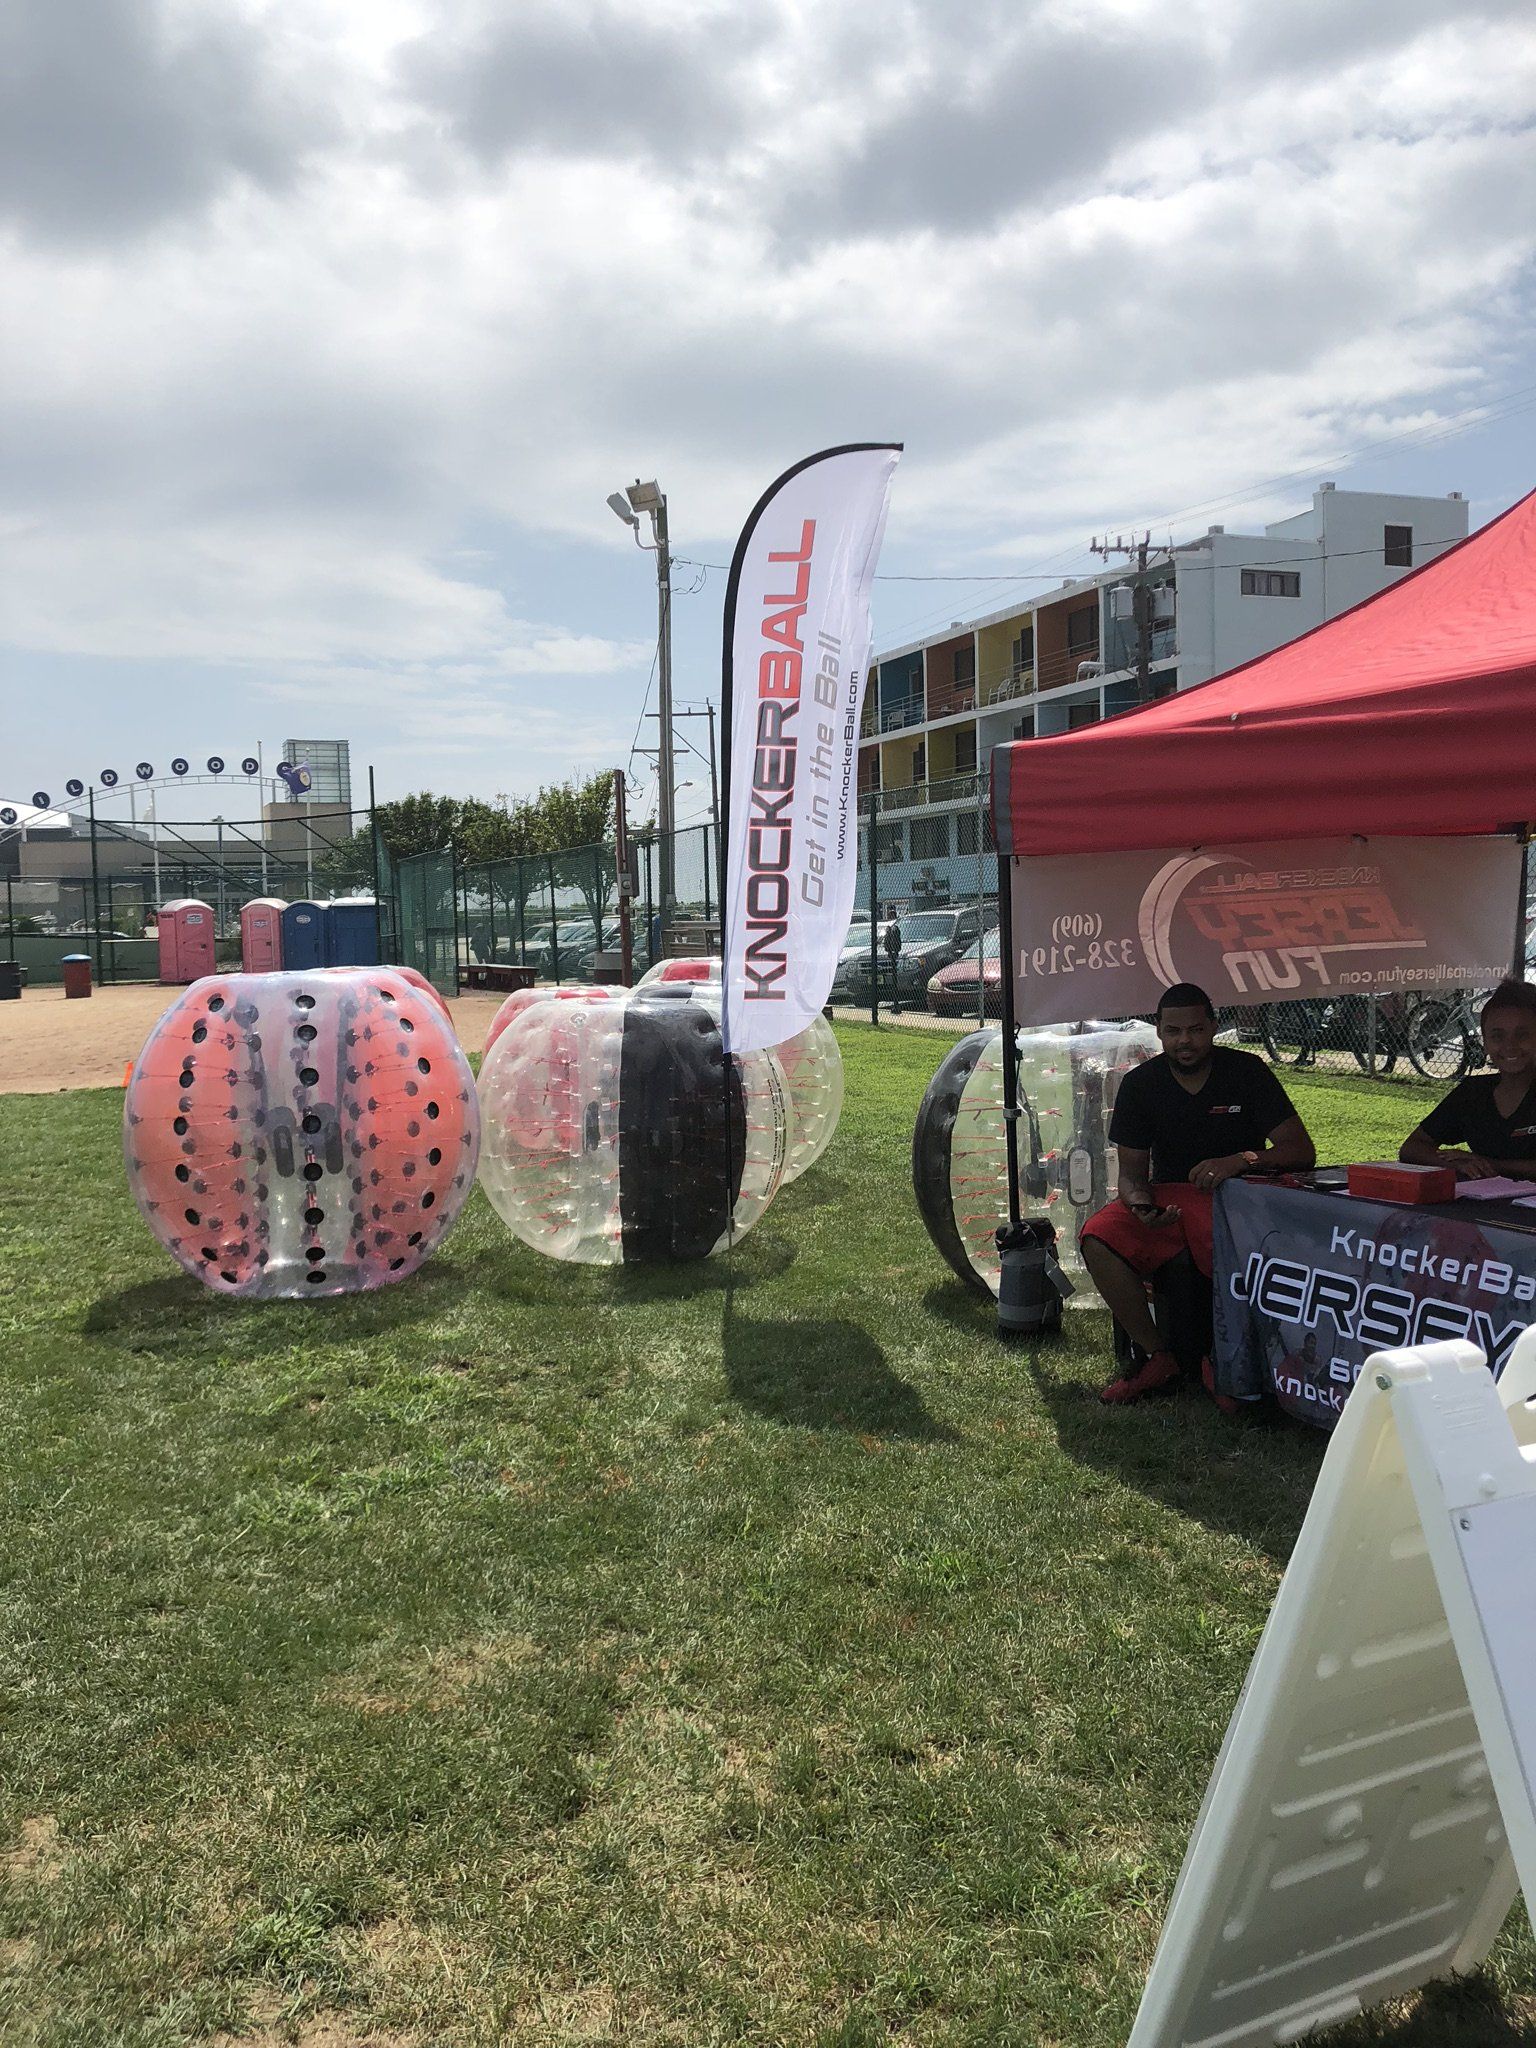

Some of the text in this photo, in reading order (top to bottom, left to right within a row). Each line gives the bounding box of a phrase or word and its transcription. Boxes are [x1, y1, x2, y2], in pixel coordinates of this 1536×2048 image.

[744, 519, 816, 1001] KNOCKERBALL
[801, 630, 841, 908] Get in the Ball
[837, 670, 858, 860] www.KnockerBall.com
[1230, 1252, 1528, 1384] JERSEY
[1330, 1226, 1536, 1301] KnockerBa
[1274, 1368, 1349, 1412] knock
